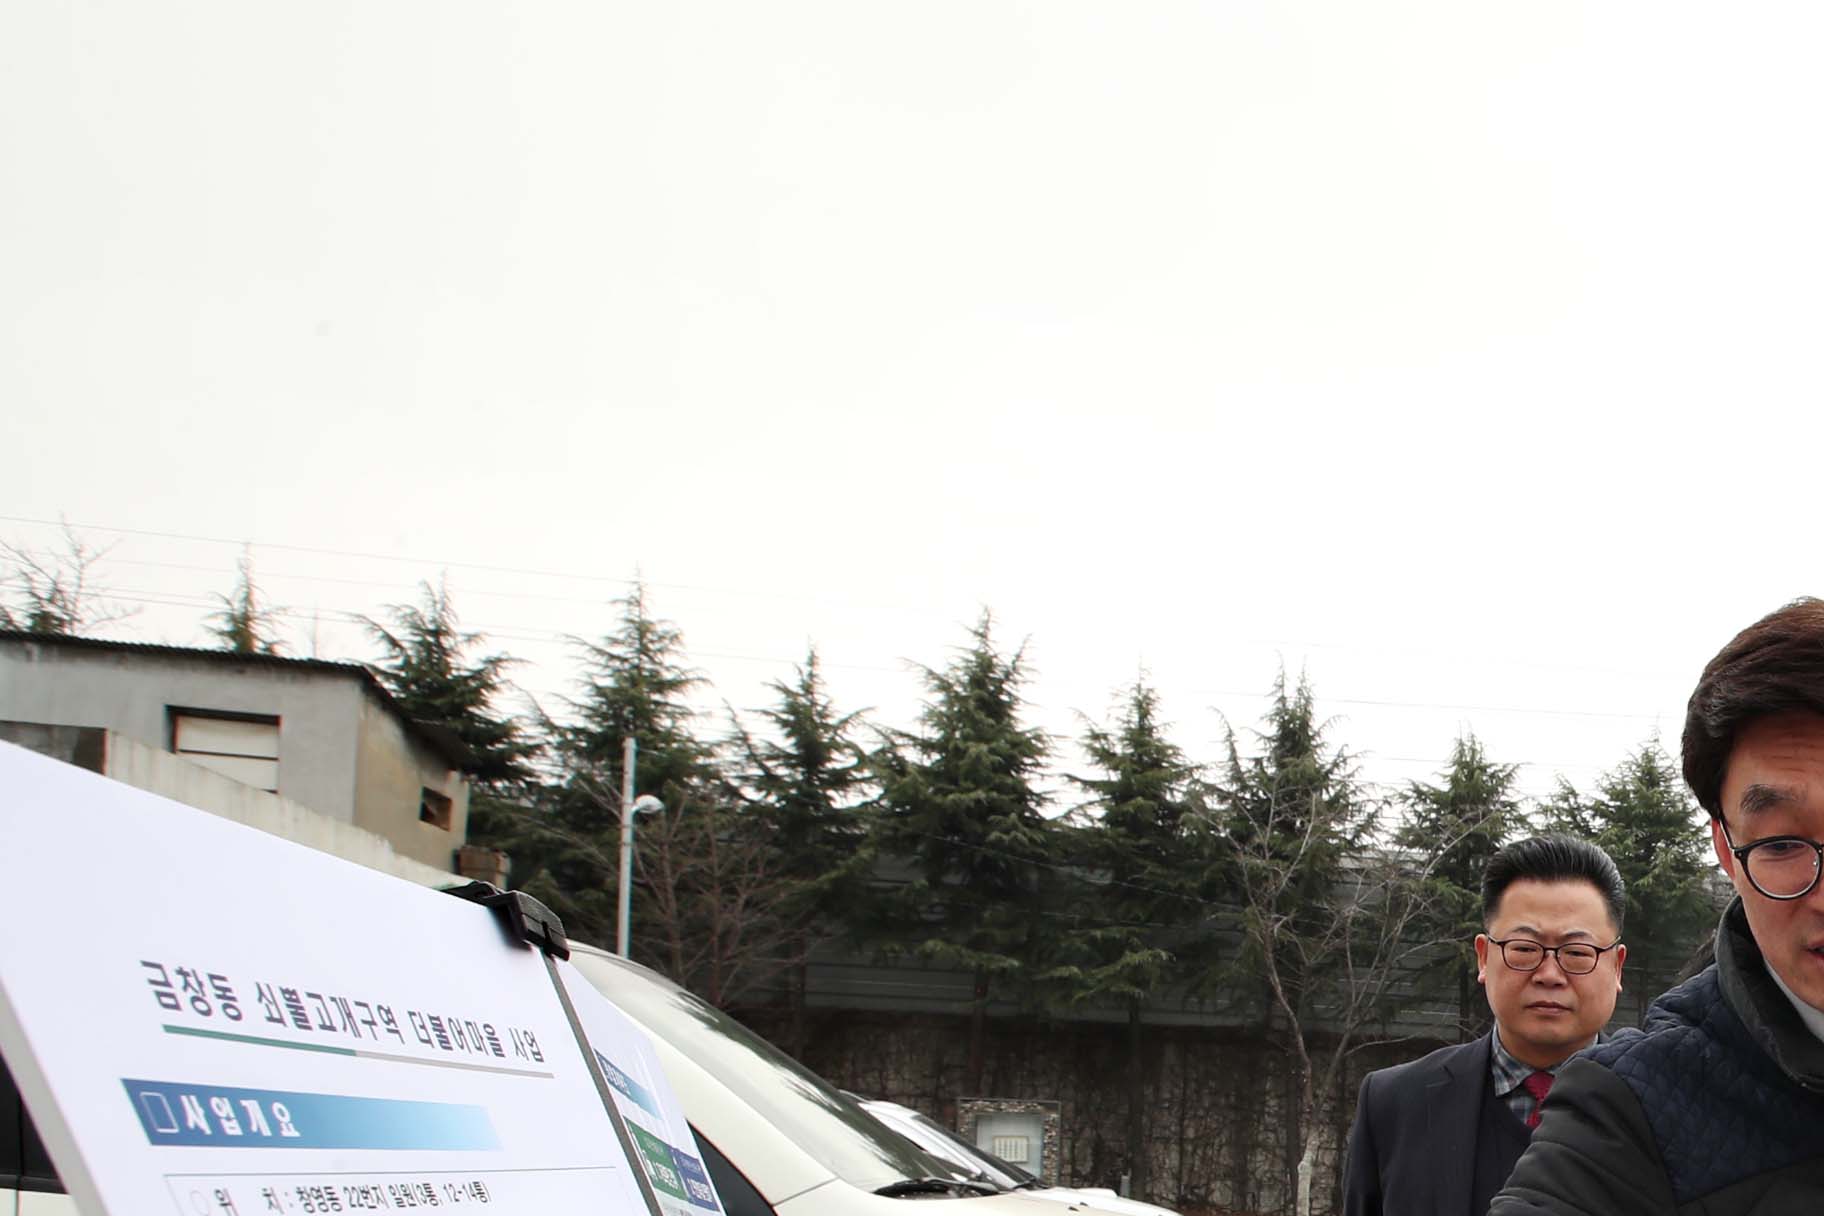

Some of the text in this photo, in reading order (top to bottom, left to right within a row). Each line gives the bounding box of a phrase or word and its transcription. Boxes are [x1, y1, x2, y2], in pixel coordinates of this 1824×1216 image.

[140, 960, 545, 1063] 금창동 쇠뿔고개구역 더불어마을 사업
[180, 1094, 301, 1137] 사업개요
[214, 1189, 238, 1216] 위
[262, 1187, 284, 1214] 치
[296, 1186, 343, 1213] 창영동
[343, 1184, 390, 1209] 22번지
